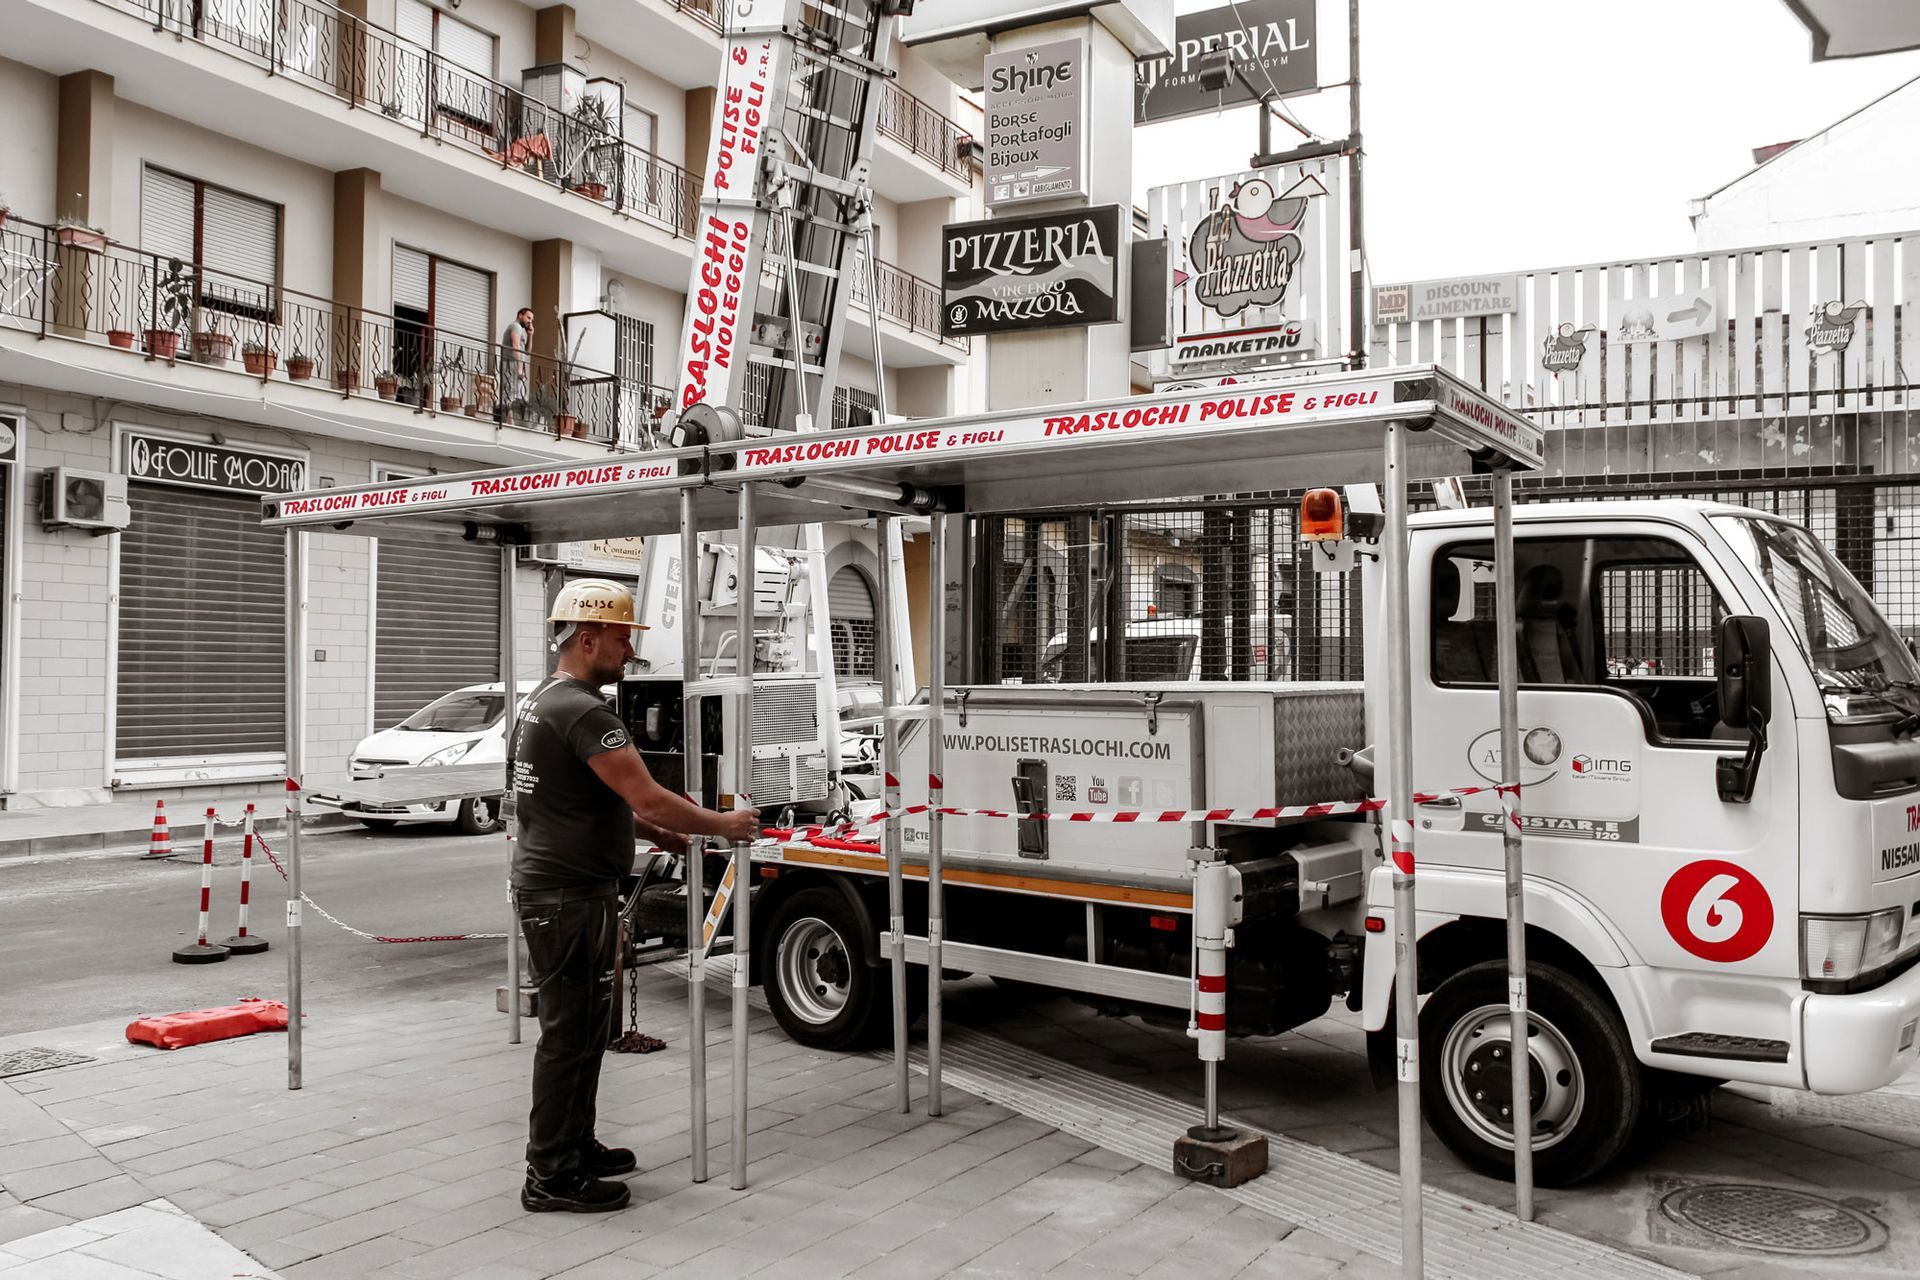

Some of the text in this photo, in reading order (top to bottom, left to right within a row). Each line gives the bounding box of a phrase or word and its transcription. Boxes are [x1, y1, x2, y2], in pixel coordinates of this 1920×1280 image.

[991, 61, 1073, 95] Shine
[1264, 56, 1289, 70] GYM
[741, 82, 765, 155] FIGLI
[714, 86, 743, 190] POLISE
[991, 150, 1040, 167] Bijoux
[1034, 180, 1071, 193] ABBIGLIAMENTO
[1206, 187, 1232, 243] La
[947, 219, 1111, 277] PIZZERIA
[1201, 240, 1288, 298] Piazzetta
[714, 221, 749, 369] NOLEGGIO
[992, 279, 1067, 297] VINCENZO
[1378, 294, 1406, 309] MD
[1426, 282, 1501, 301] DISCOUNT
[681, 216, 729, 414] RASLOCHI
[975, 291, 1085, 322] MAZZOLA
[1417, 296, 1512, 317] ALIMENTARE
[1810, 325, 1850, 345] Piazzetta
[1043, 391, 1378, 437] TRASLOCHI POLISE & FIGLI
[1450, 388, 1494, 430] TRASLOCHI
[1495, 415, 1518, 442] POLISE
[745, 430, 1004, 467] TRASLOCHI POLISE & FIGLI
[150, 445, 291, 490] FOLLIE MODA
[471, 465, 671, 496] TRASLOCHI POLISE & FIGLI
[284, 489, 448, 516] TRASLOCHI POLISE & FIGLI
[571, 598, 614, 610] POLISE
[662, 583, 680, 630] CTE
[943, 734, 1171, 761] WW.POLISETRASLOCHI.COM
[1594, 759, 1632, 772] IMG
[1089, 788, 1108, 802] Tube
[1091, 775, 1105, 787] You
[915, 831, 930, 841] CTE
[1594, 831, 1621, 842] 120
[1881, 841, 1920, 871] NISSAN
[1687, 873, 1744, 944] 6
